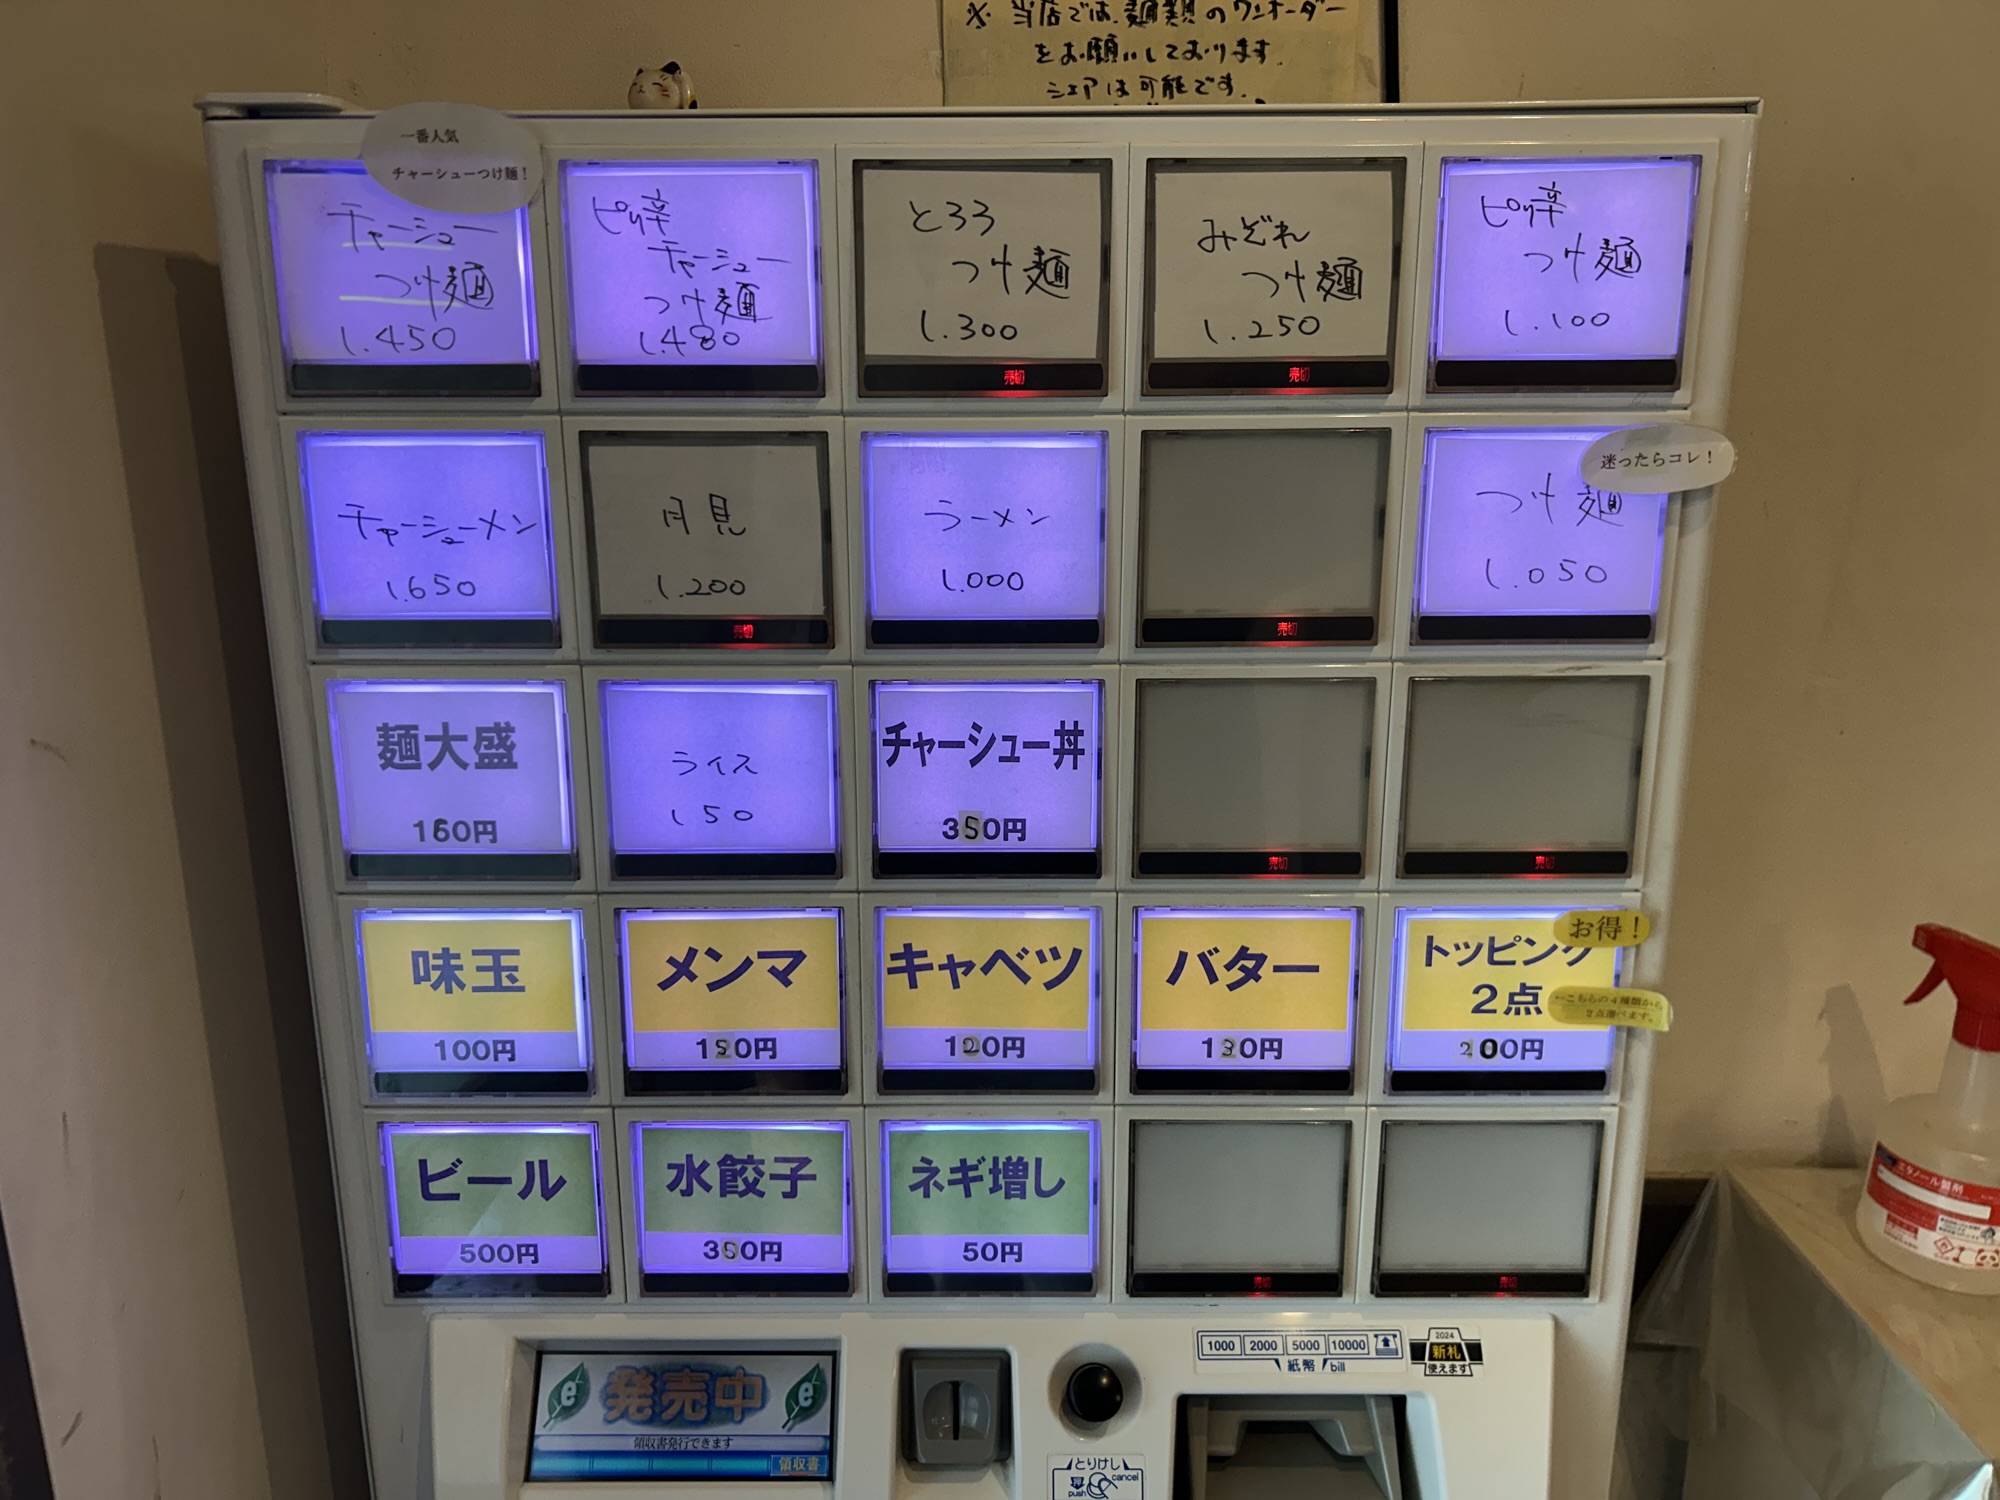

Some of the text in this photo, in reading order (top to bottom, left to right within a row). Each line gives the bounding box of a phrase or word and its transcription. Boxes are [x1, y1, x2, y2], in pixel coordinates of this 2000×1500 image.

[400, 128, 459, 143] 一番人気
[392, 166, 527, 180] チャーシューつけ麺！
[593, 188, 670, 236] ピリ辛
[1480, 181, 1567, 227] ピリ辛
[327, 202, 499, 254] チャーシュー
[910, 200, 995, 236] とろろ
[1198, 215, 1311, 253] みぞれ
[647, 240, 792, 279] チャーシュー
[1524, 232, 1642, 283] つけ麺
[952, 244, 1071, 300] つけ麺
[1242, 257, 1363, 301] つけ麺
[374, 261, 494, 322] つけ麺
[644, 281, 773, 325] つけ麺
[1004, 370, 1025, 385] 売切
[1289, 367, 1311, 383] 売切
[1600, 450, 1713, 470] 迷ったらコレ！
[338, 504, 537, 546] チャーシューメン
[663, 493, 746, 535] 月見
[924, 500, 1050, 531] ラーメン
[733, 624, 754, 639] 売切
[1277, 621, 1298, 637] 売切
[376, 721, 518, 771] 麺大盛
[882, 720, 1085, 770] チャーシュー丼
[672, 751, 758, 776] ライス
[672, 804, 754, 826] 150
[942, 816, 1026, 841] 350円
[1268, 856, 1288, 871] 売切
[1535, 855, 1555, 870] 売切
[1569, 914, 1641, 941] お得！
[411, 946, 526, 994] 味玉
[657, 946, 807, 993] メンマ
[886, 942, 1083, 991] キャベツ
[1166, 945, 1319, 992] バター
[1471, 982, 1543, 1016] 2点
[434, 1039, 516, 1062] 100円
[945, 1035, 1025, 1059] 120円
[1201, 1036, 1283, 1060] 130円
[418, 1157, 567, 1202] ビール
[666, 1153, 817, 1199] 水餃子
[908, 1156, 1066, 1200] ネギ増し
[460, 1243, 539, 1265] 500円
[703, 1239, 783, 1262] 350円
[963, 1242, 1023, 1263] 50円
[1207, 1339, 1366, 1351] 1000 2000 5000 10000
[1435, 1331, 1454, 1339] 2024
[1432, 1344, 1461, 1360] 新札
[1287, 1359, 1315, 1372] 紙幣
[1330, 1361, 1346, 1372] bill
[1428, 1363, 1468, 1374] 使えます
[605, 1366, 765, 1422] 発売中
[633, 1437, 733, 1450] 領収書発行できます
[778, 1456, 820, 1471] 領収書
[1075, 1457, 1120, 1470] とりけし
[1112, 1472, 1139, 1481] cancel
